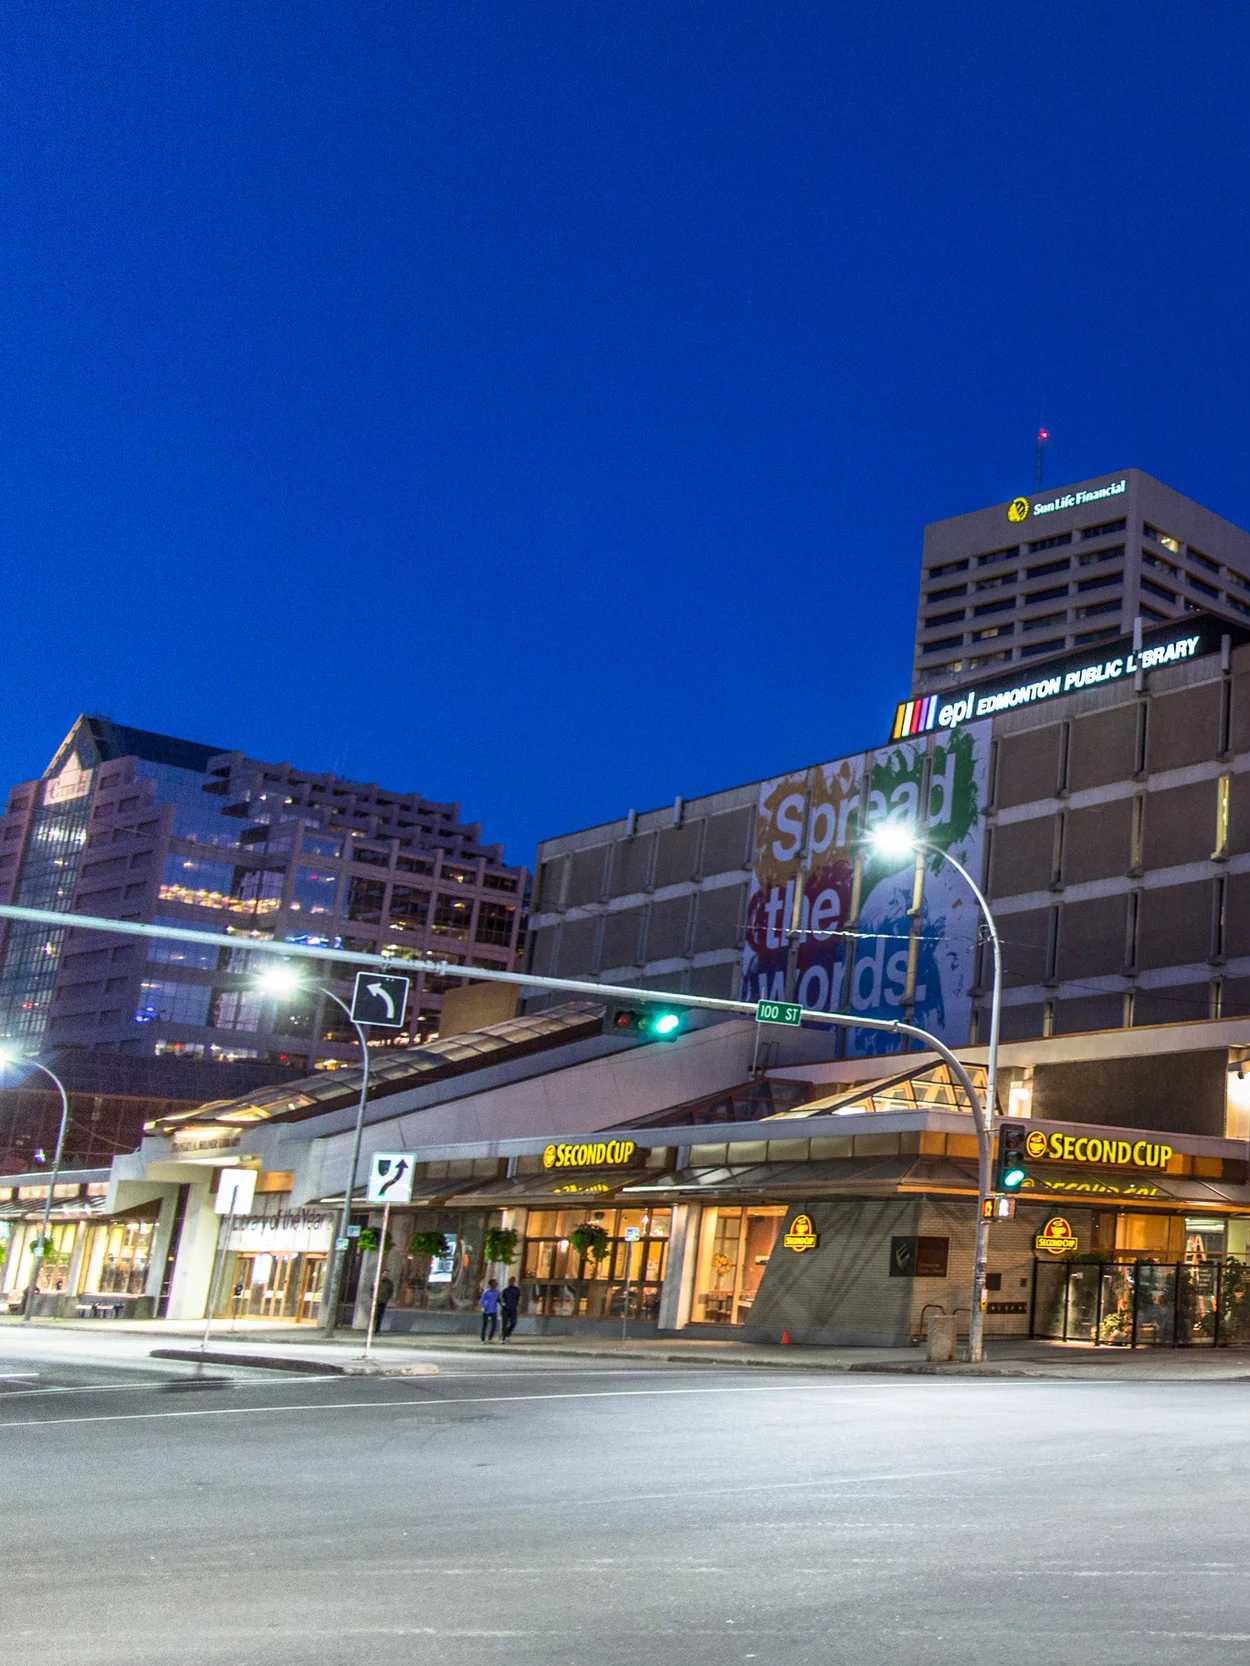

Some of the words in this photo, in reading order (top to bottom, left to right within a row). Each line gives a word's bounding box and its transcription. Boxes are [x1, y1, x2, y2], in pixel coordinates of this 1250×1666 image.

[1033, 503, 1055, 517] Sun
[1055, 494, 1075, 511] Life
[1076, 480, 1127, 505] Financial
[938, 692, 975, 728] epl
[976, 676, 1062, 716] EDMONTON
[1064, 659, 1123, 692] PUBLIC
[1125, 636, 1200, 674] LBRARY
[772, 752, 956, 871] Spread
[765, 879, 841, 950] the
[757, 942, 927, 1012] words.
[760, 1004, 779, 1019] 100
[785, 1008, 799, 1021] ST
[555, 1144, 606, 1167] SECOND
[606, 1140, 635, 1164] CUP
[1049, 1133, 1132, 1165] SECOND
[1133, 1140, 1173, 1168] CUP
